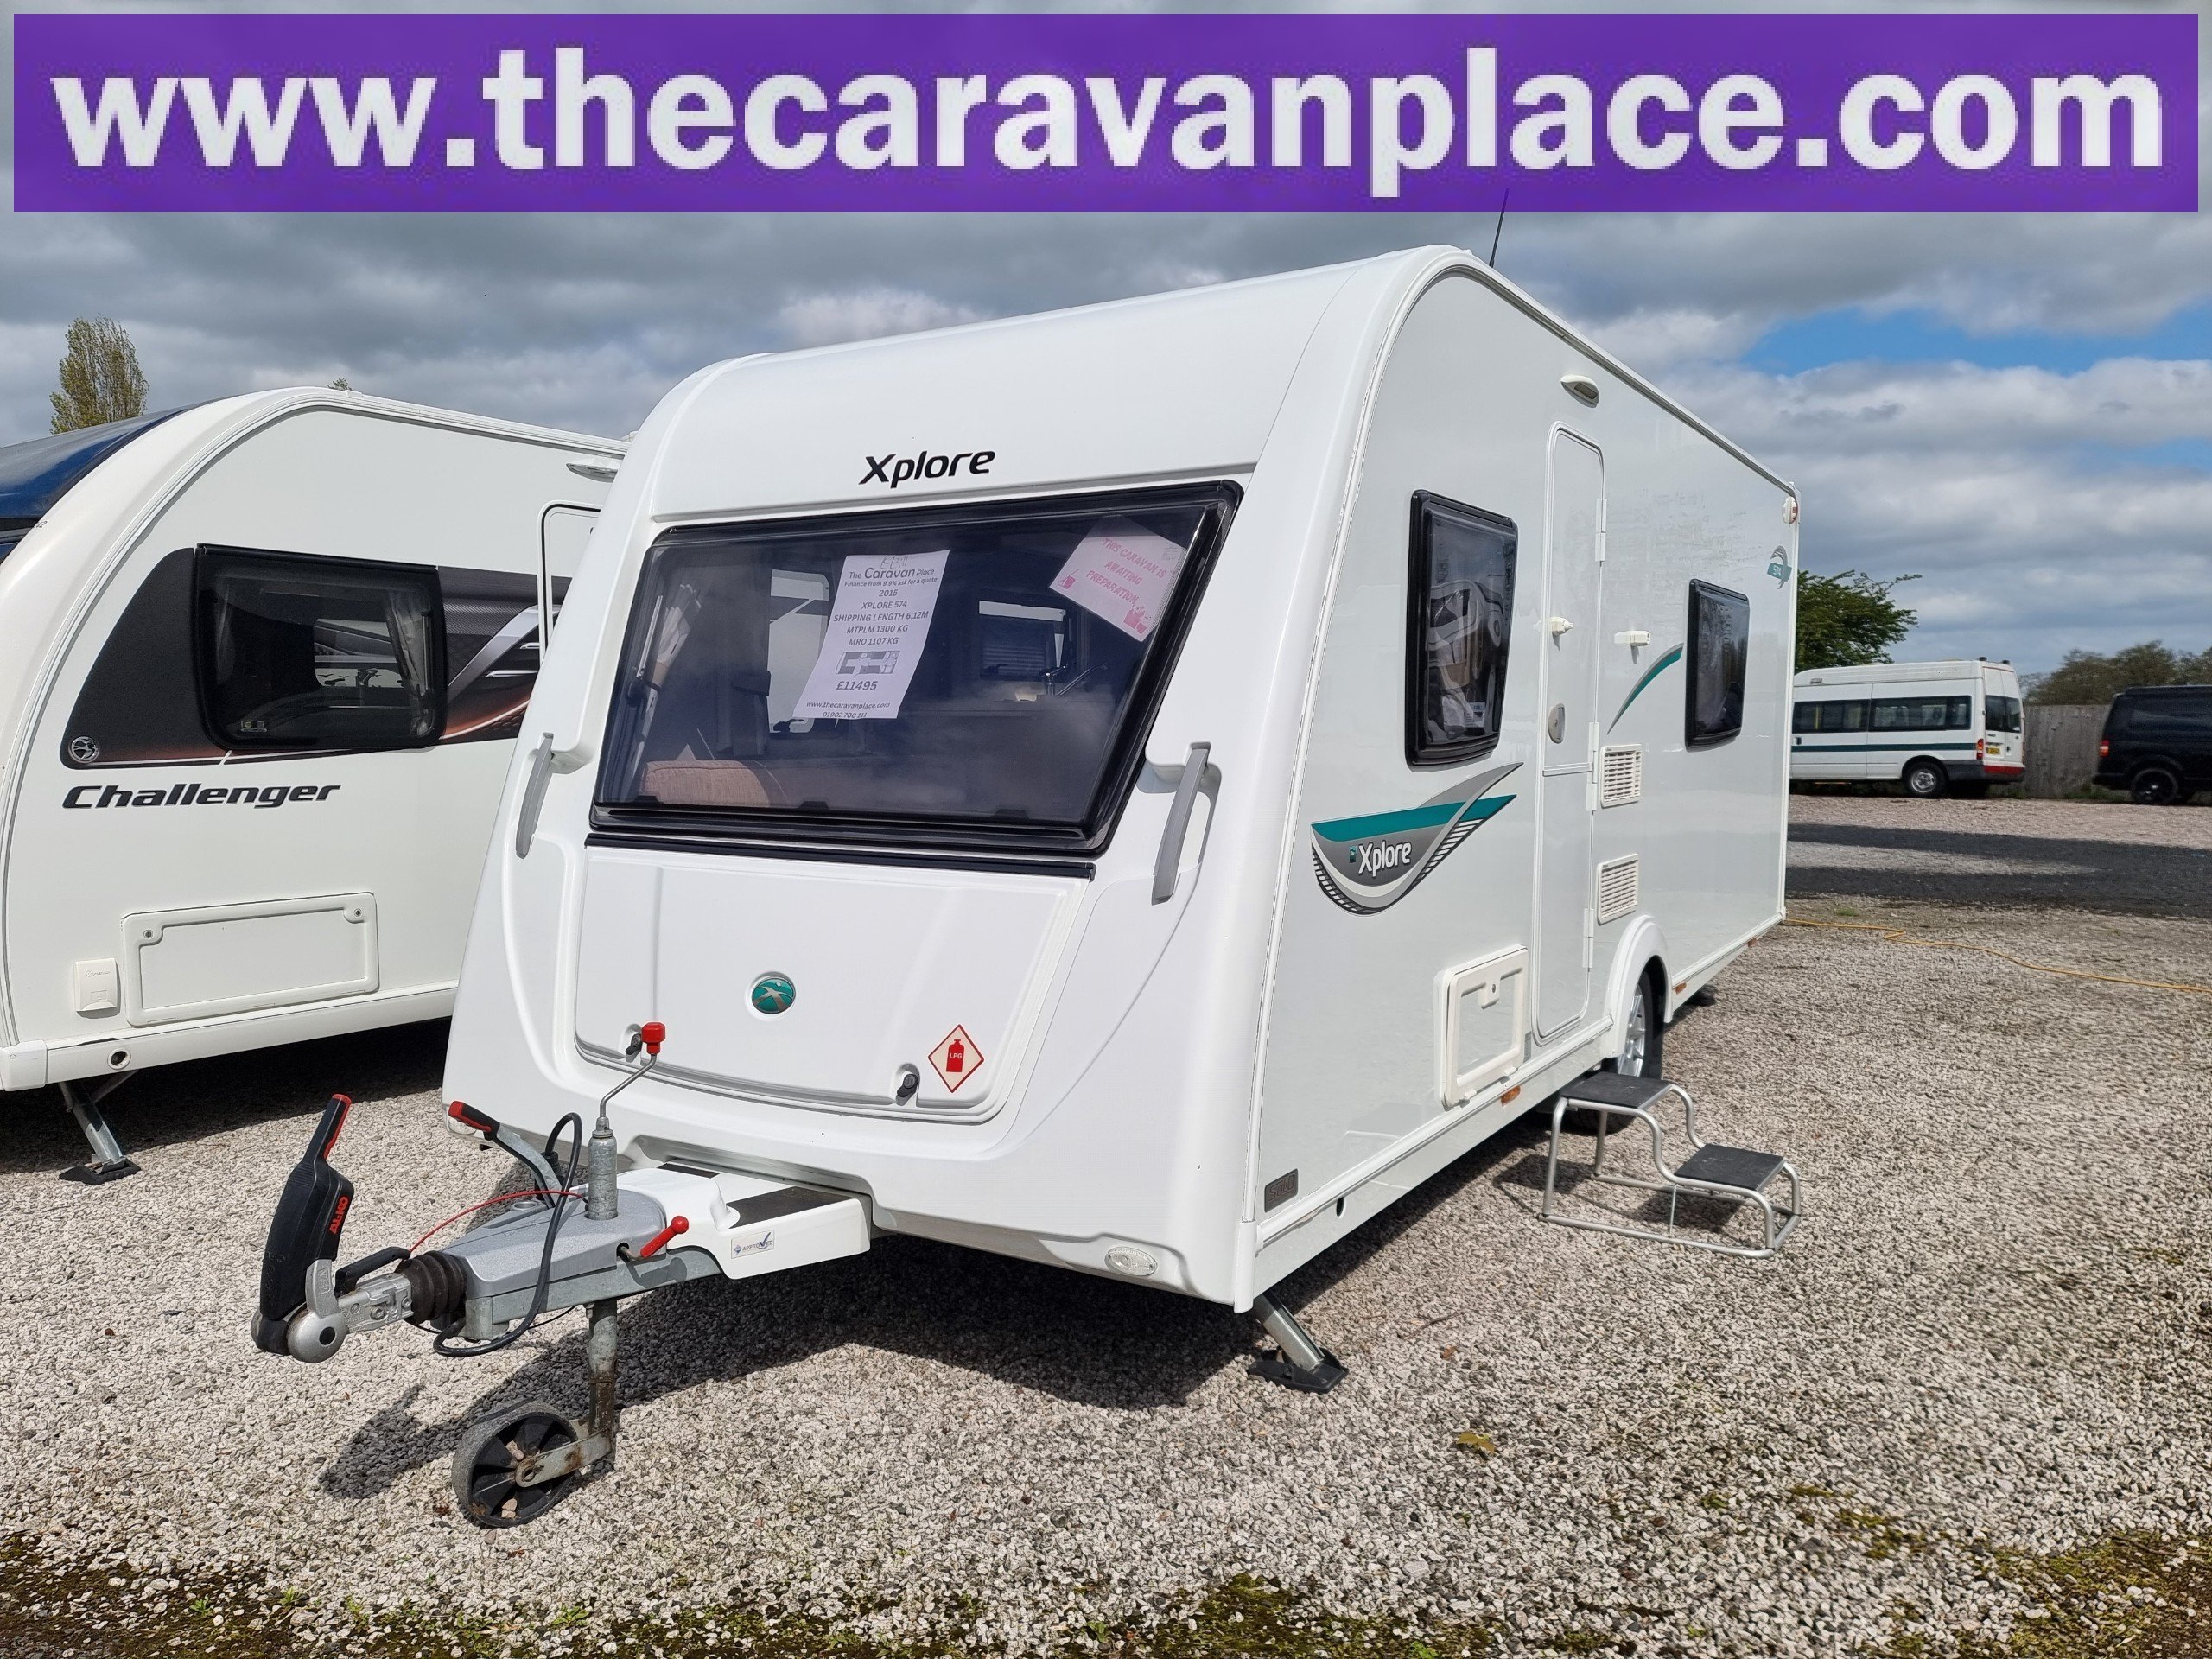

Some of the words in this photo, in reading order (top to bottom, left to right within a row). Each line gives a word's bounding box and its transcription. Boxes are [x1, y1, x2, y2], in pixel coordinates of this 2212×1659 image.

[858, 450, 995, 489] Xplore
[1102, 538, 1119, 553] THIS
[1119, 549, 1157, 573] CARAVAN
[1156, 568, 1167, 579] IS
[864, 567, 916, 579] Caravan
[1104, 561, 1143, 585] AWAITING
[1086, 570, 1140, 605] PREPARATION
[873, 613, 905, 621] LENGTH
[906, 611, 929, 620] 6.12M
[875, 625, 896, 633] 1300
[836, 681, 878, 690] £11495
[806, 702, 890, 710] www.thecaravanplace.com
[62, 783, 341, 809] Challenger
[1357, 839, 1411, 877] Xplore
[329, 1196, 349, 1234] AL-KO
